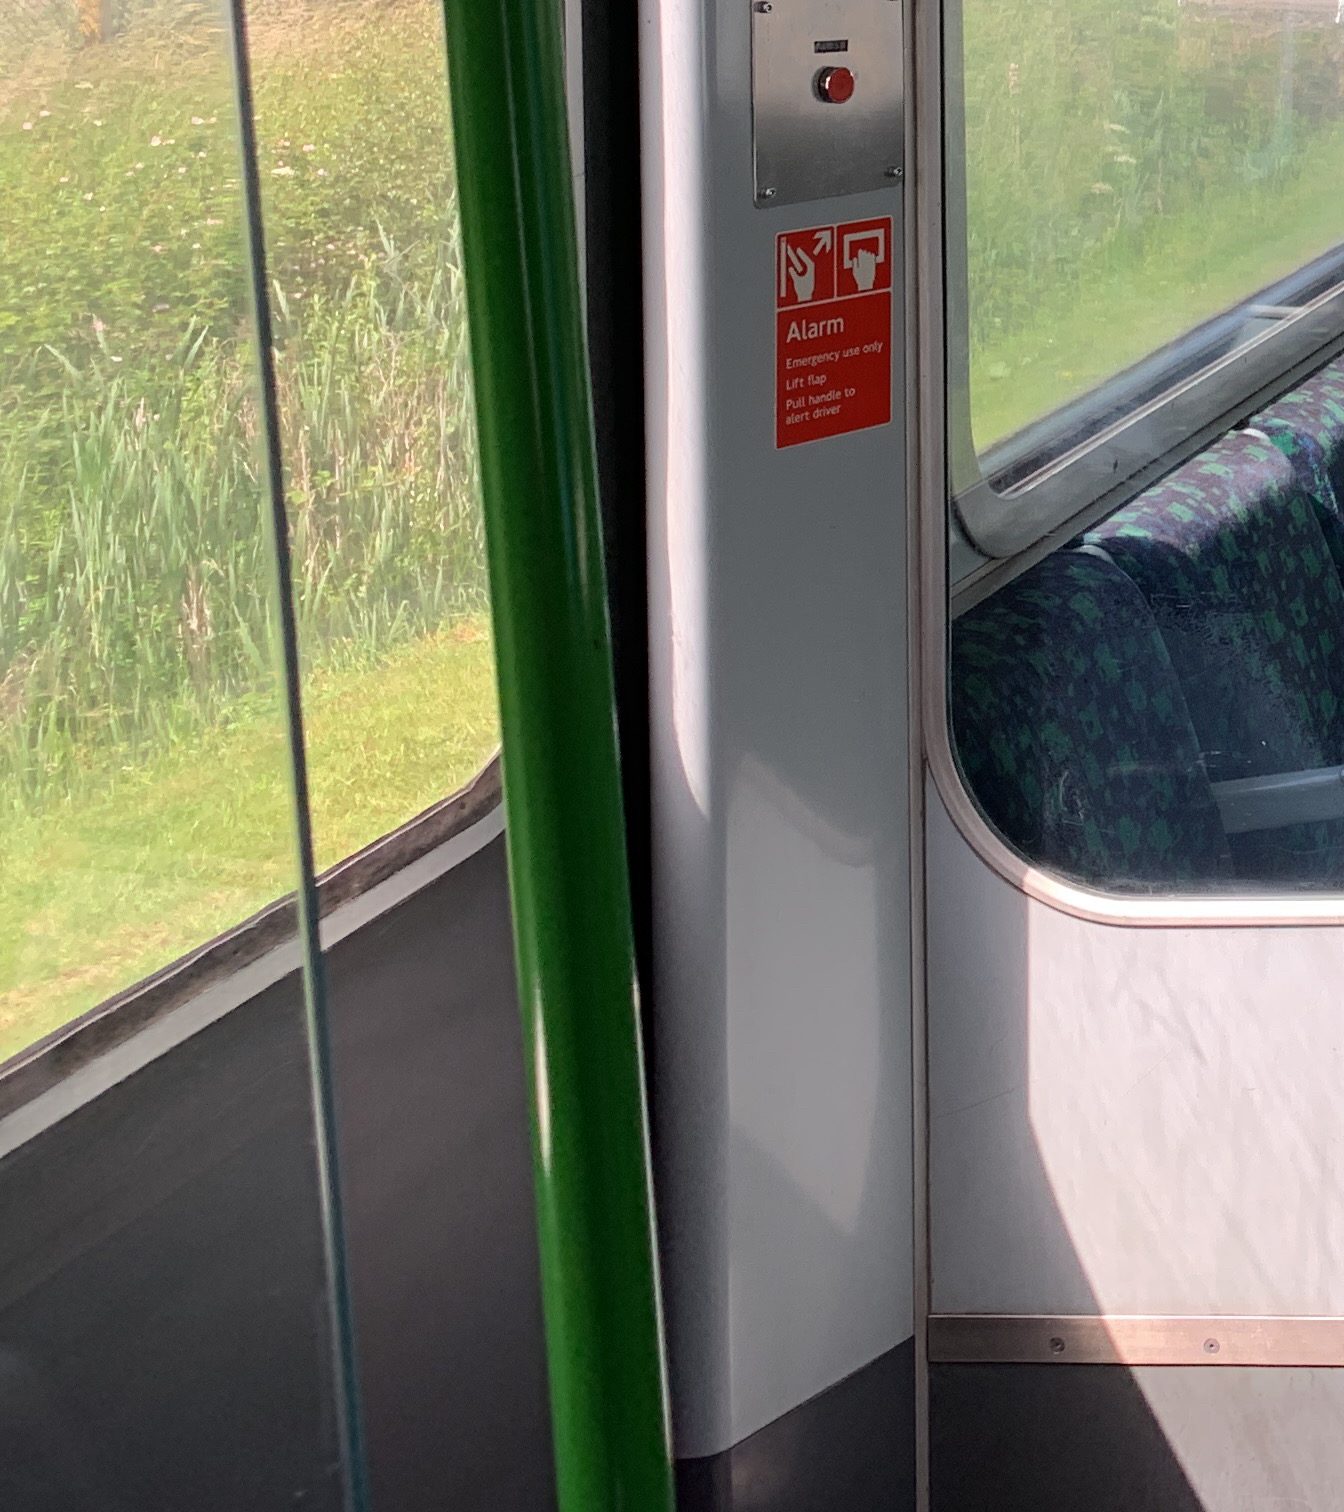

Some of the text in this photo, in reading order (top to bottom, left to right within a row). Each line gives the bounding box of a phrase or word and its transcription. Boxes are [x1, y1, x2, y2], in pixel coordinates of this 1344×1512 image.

[786, 317, 845, 343] Alarm
[786, 341, 883, 369] Emergency use only
[786, 374, 826, 390] Lift flap
[786, 388, 855, 410] Pull handle to
[786, 405, 841, 425] alert driver
